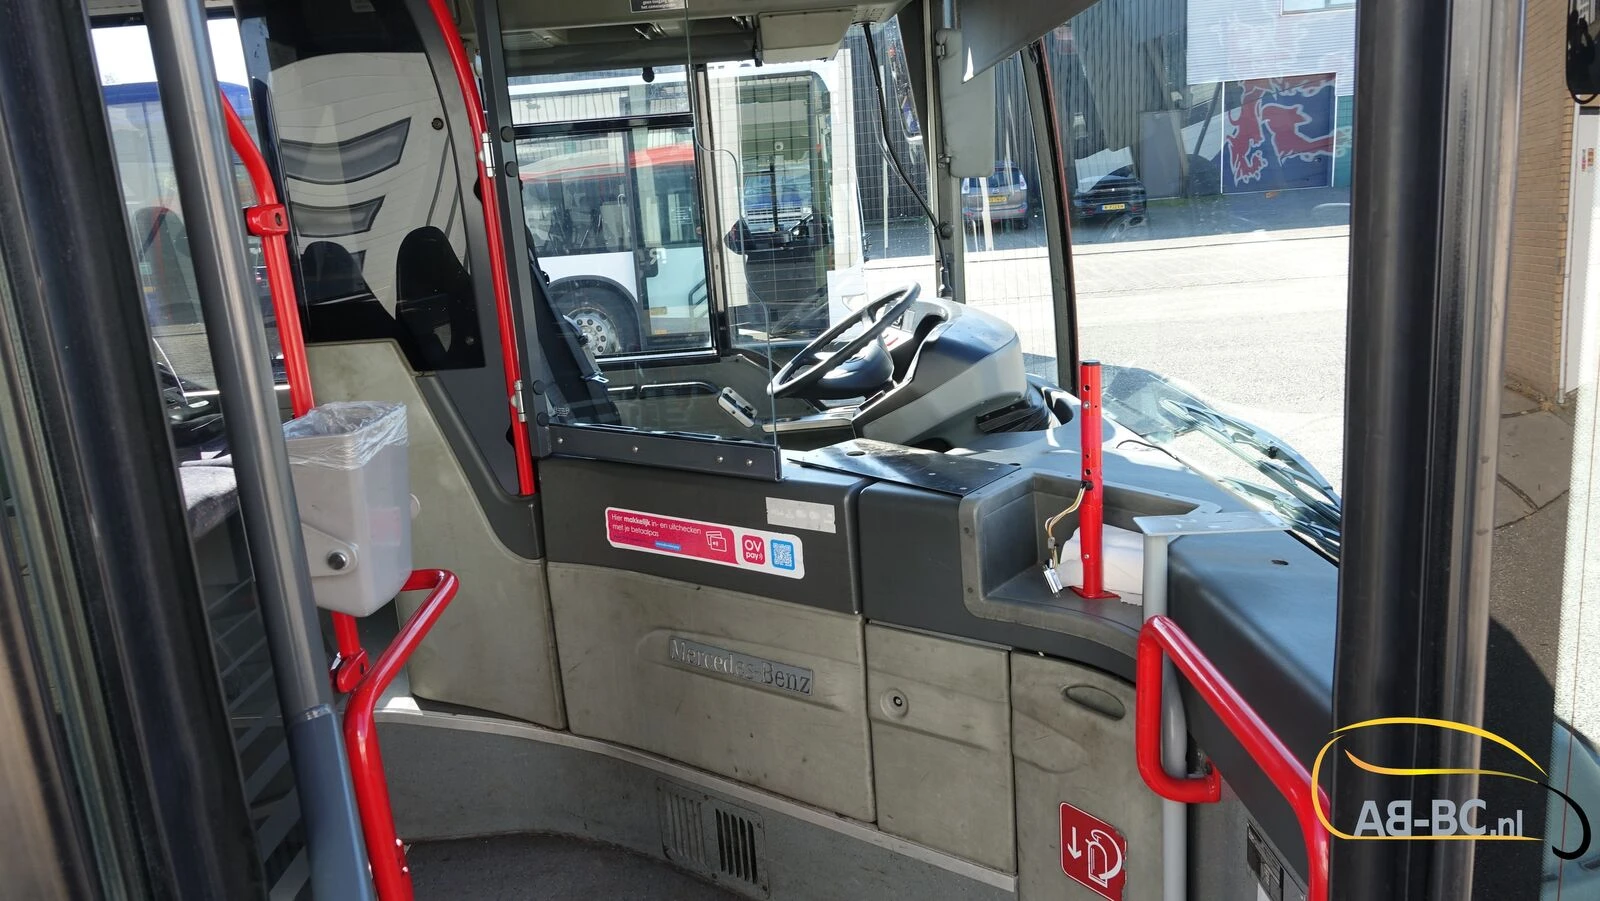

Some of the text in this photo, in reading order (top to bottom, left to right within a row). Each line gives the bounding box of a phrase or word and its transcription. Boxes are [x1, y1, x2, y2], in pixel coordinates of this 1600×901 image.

[623, 515, 650, 527] makkelijk
[651, 519, 659, 527] in-
[668, 522, 702, 535] uitchecken
[624, 525, 630, 533] je
[631, 526, 659, 537] betaalpas
[744, 539, 762, 552] OV
[745, 551, 759, 560] pay
[670, 639, 811, 695] Mercedes-Benz
